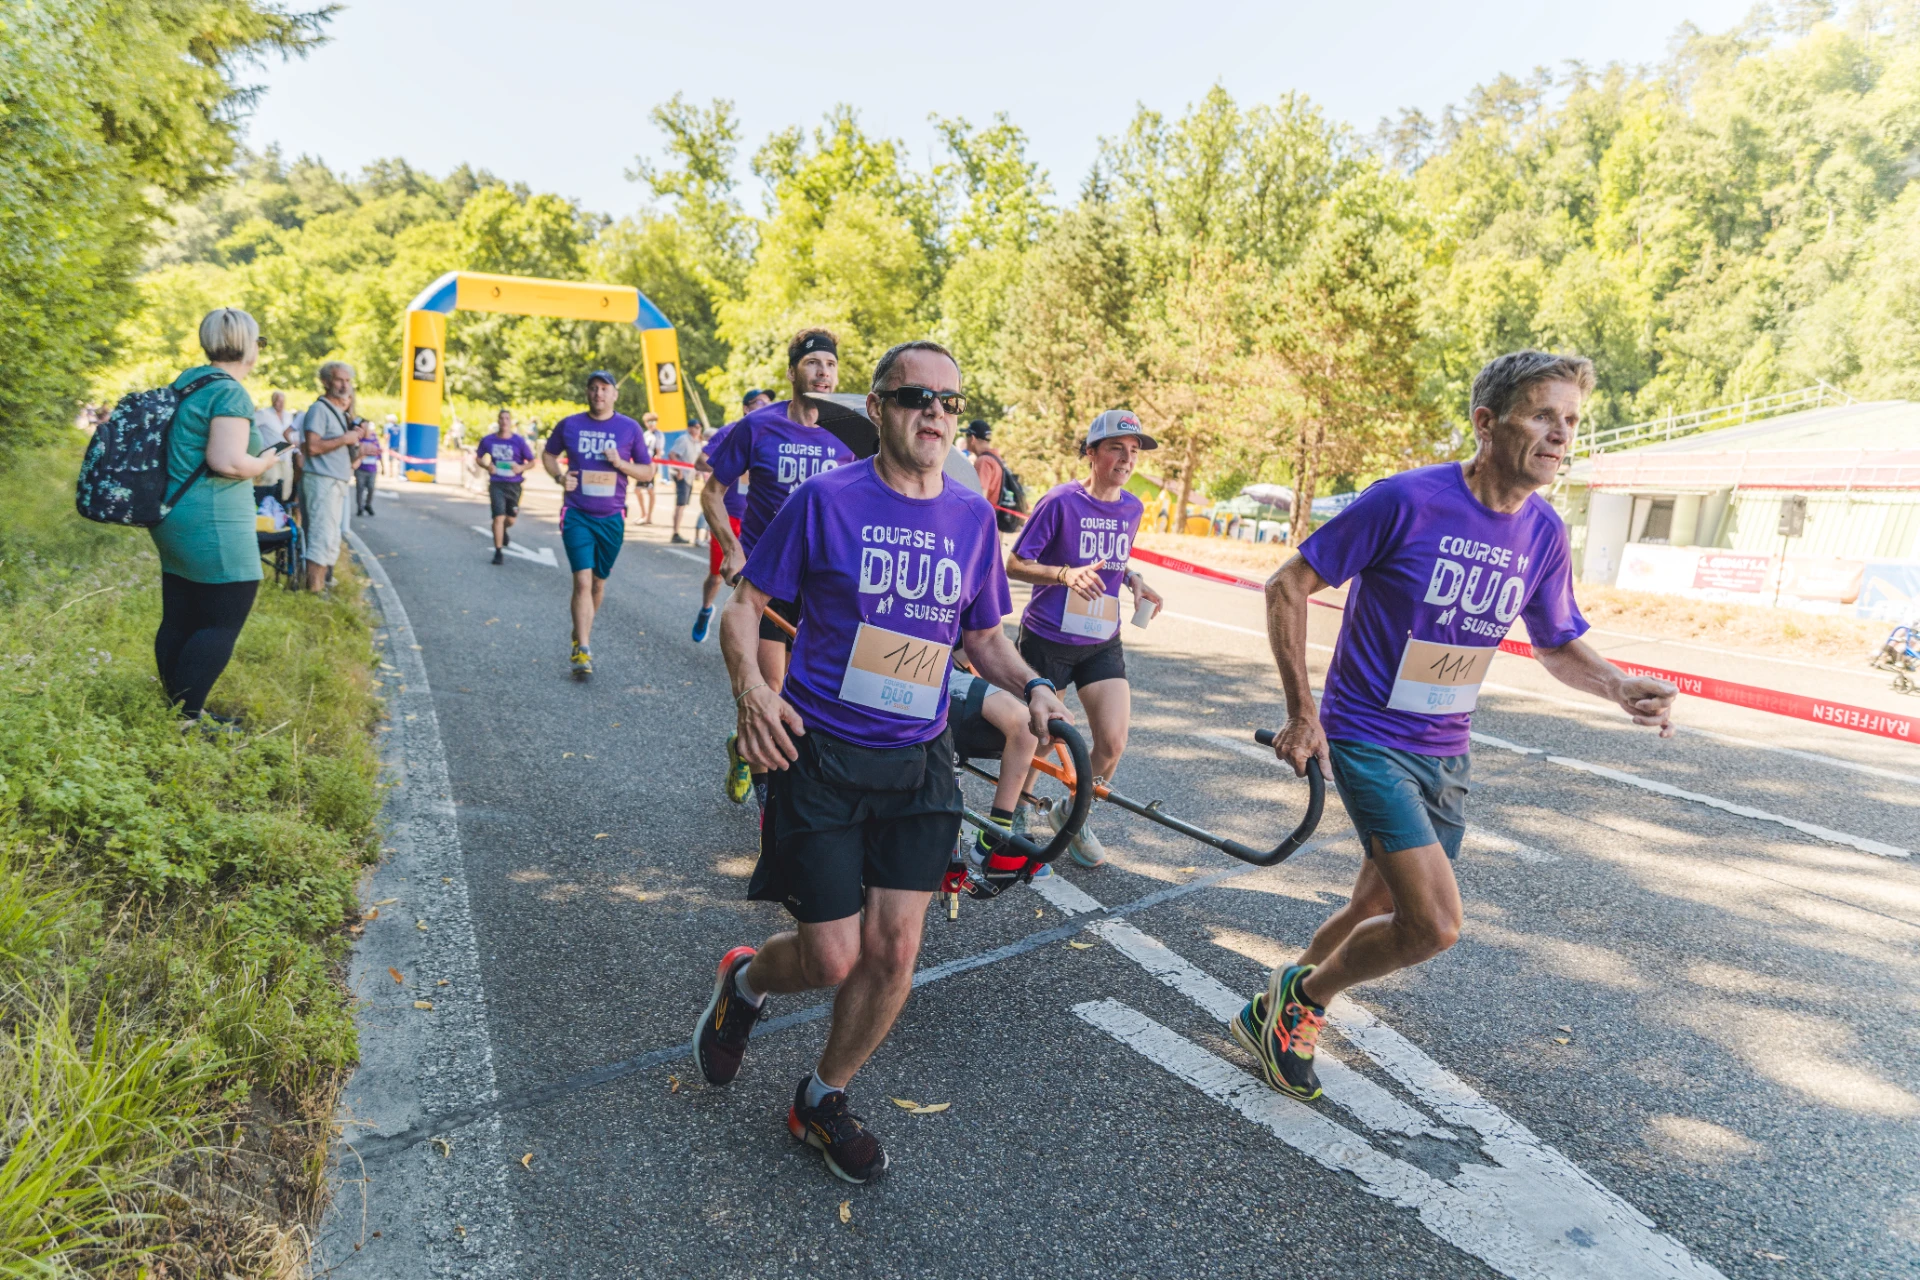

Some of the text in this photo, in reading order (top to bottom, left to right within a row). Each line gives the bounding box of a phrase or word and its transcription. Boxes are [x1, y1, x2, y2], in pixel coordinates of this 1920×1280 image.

[578, 437, 617, 454] DUO
[779, 443, 822, 456] COURSE
[1080, 517, 1118, 530] COURSE
[862, 525, 936, 551] COURSE
[1079, 530, 1129, 561] DUO
[1439, 535, 1513, 568] COURSE
[859, 547, 962, 605] DUO
[1423, 557, 1525, 623] DUO
[904, 603, 956, 623] SUISSE
[1461, 617, 1510, 638] SUISSE
[884, 642, 941, 682] 111
[1430, 653, 1477, 681] 111
[881, 685, 914, 705] DUO
[884, 679, 907, 690] COURSE
[1427, 692, 1456, 706] DUO
[1813, 703, 1911, 737] RAIFFEISEN
